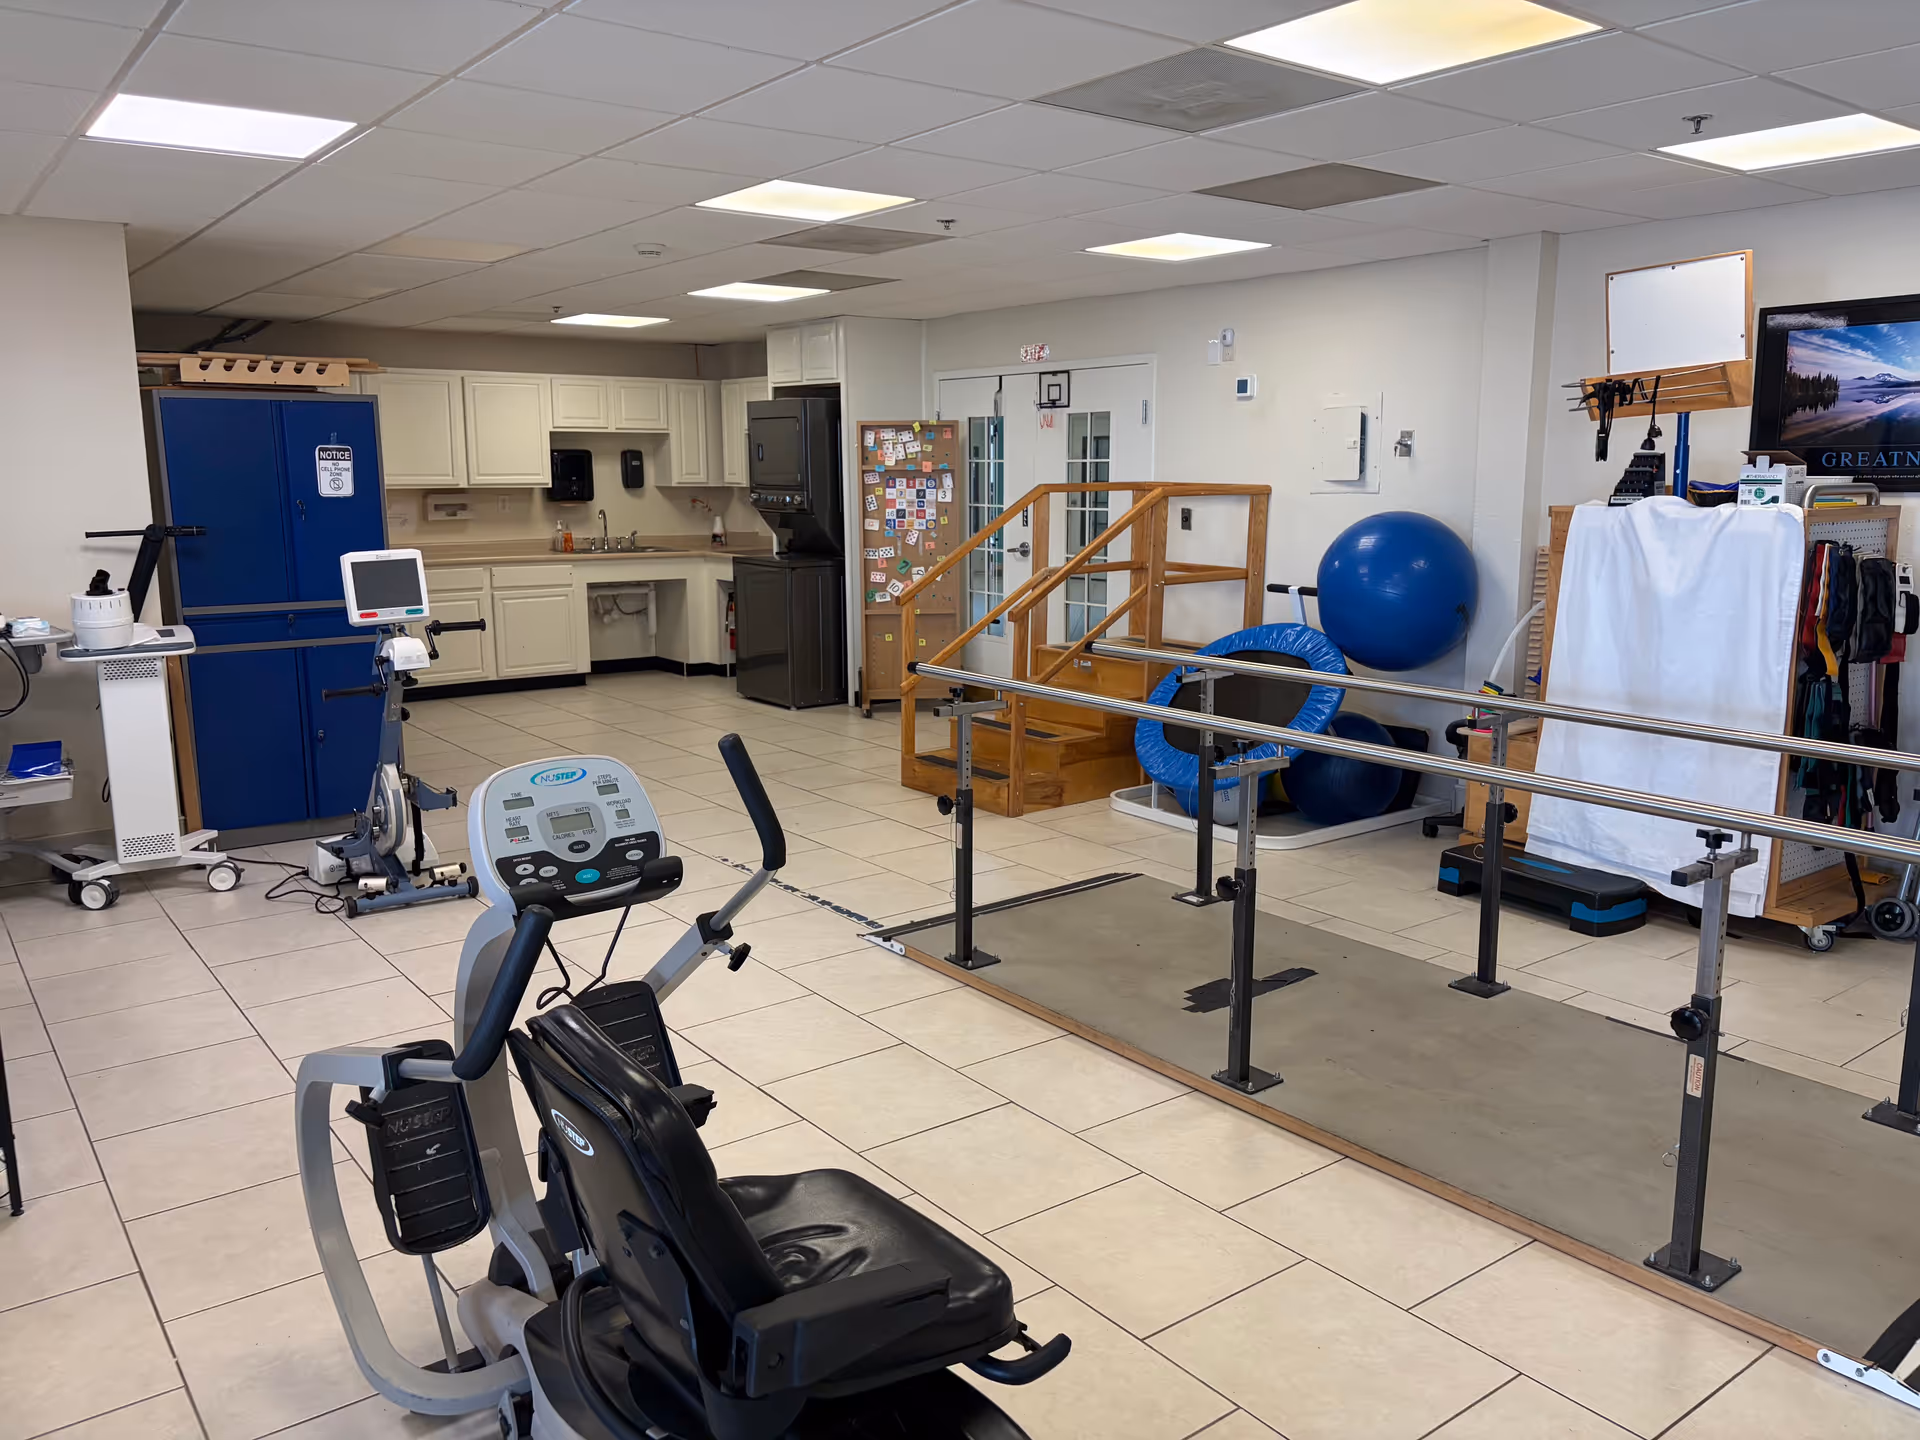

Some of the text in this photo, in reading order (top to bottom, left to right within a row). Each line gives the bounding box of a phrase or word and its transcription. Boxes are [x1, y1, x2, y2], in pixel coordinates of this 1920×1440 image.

[320, 451, 350, 460] NOTICE
[1821, 451, 1920, 467] GREATN
[940, 490, 947, 499] 3
[899, 560, 910, 571] 7
[889, 583, 900, 593] 10
[540, 771, 577, 783] NUSTEP
[606, 798, 631, 806] WORKLOAD
[552, 832, 575, 840] CALORIES
[1694, 1062, 1703, 1091] CAUTION
[557, 1117, 586, 1147] NUSTEP
